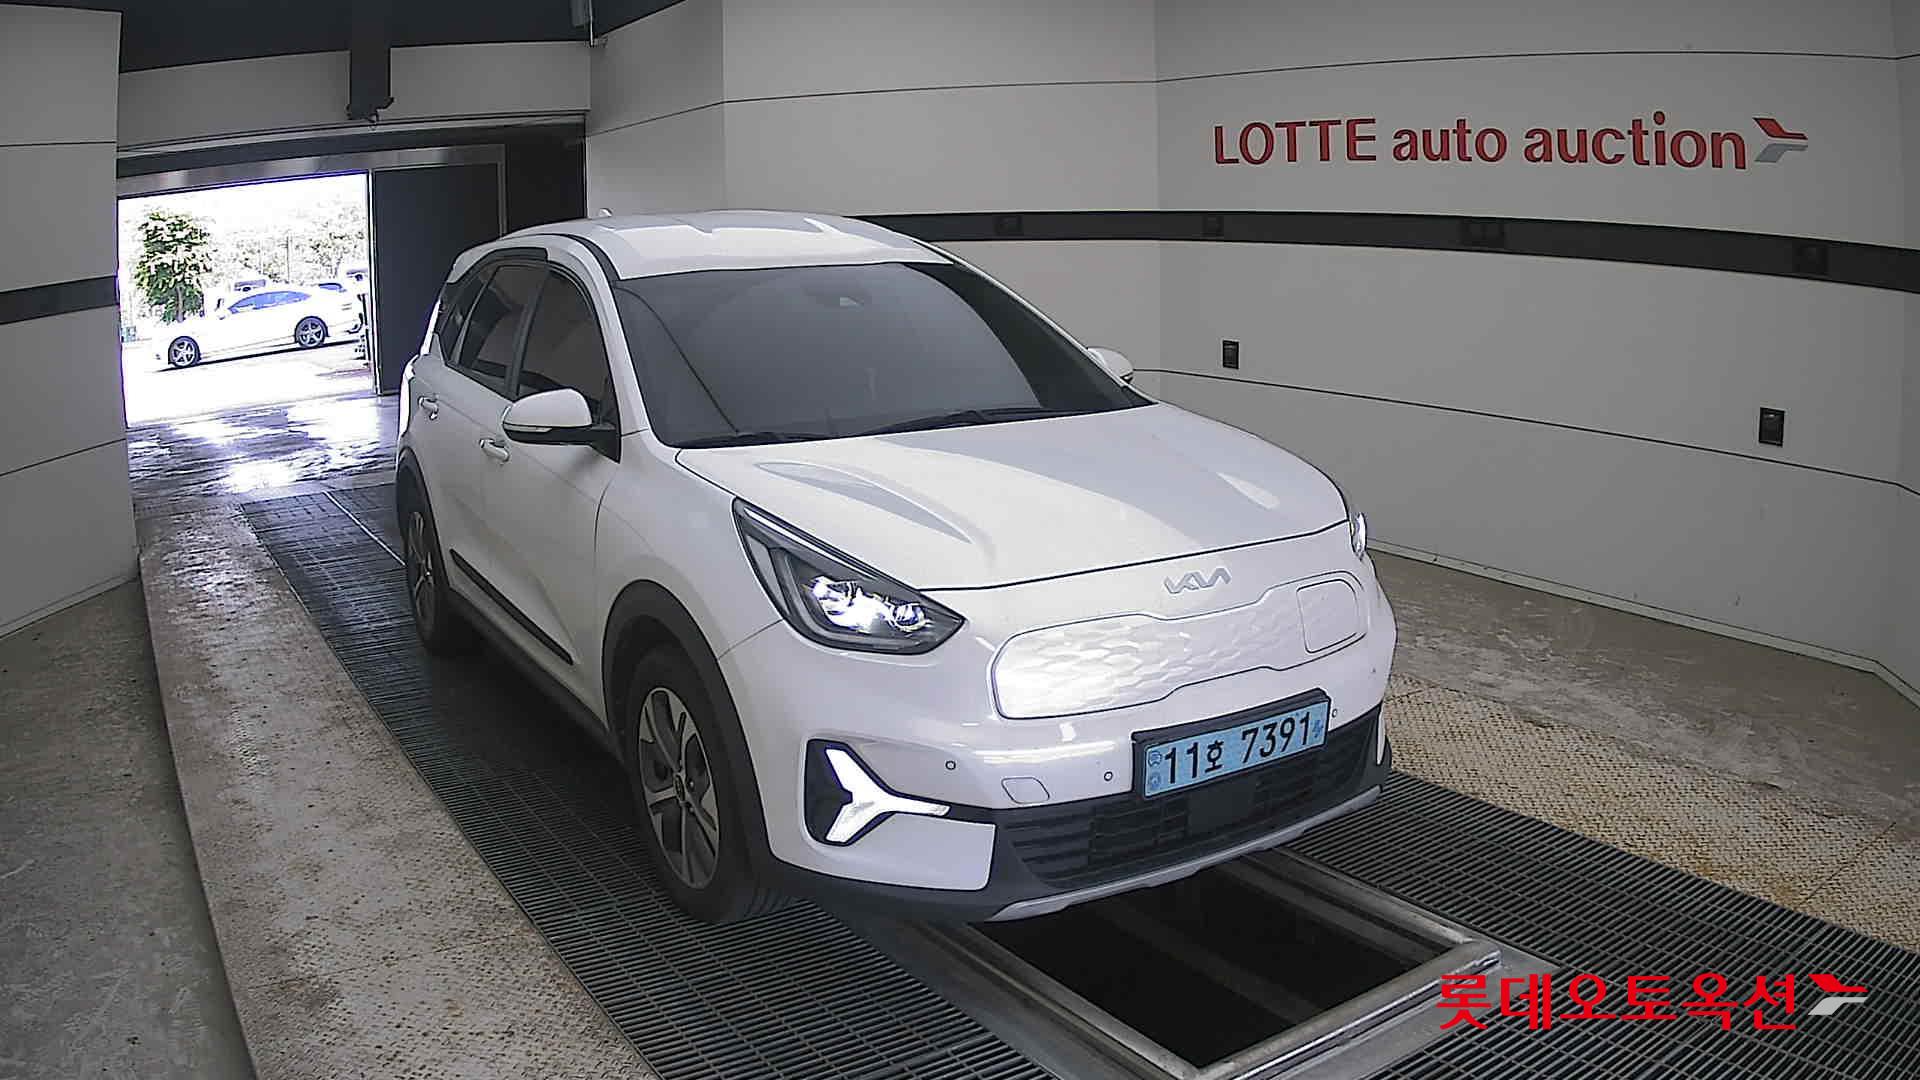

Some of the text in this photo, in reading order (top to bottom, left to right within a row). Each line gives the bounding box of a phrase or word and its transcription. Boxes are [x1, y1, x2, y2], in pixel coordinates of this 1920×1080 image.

[1214, 110, 1747, 170] LOTTE auto auction
[1164, 711, 1311, 785] 11호 7391
